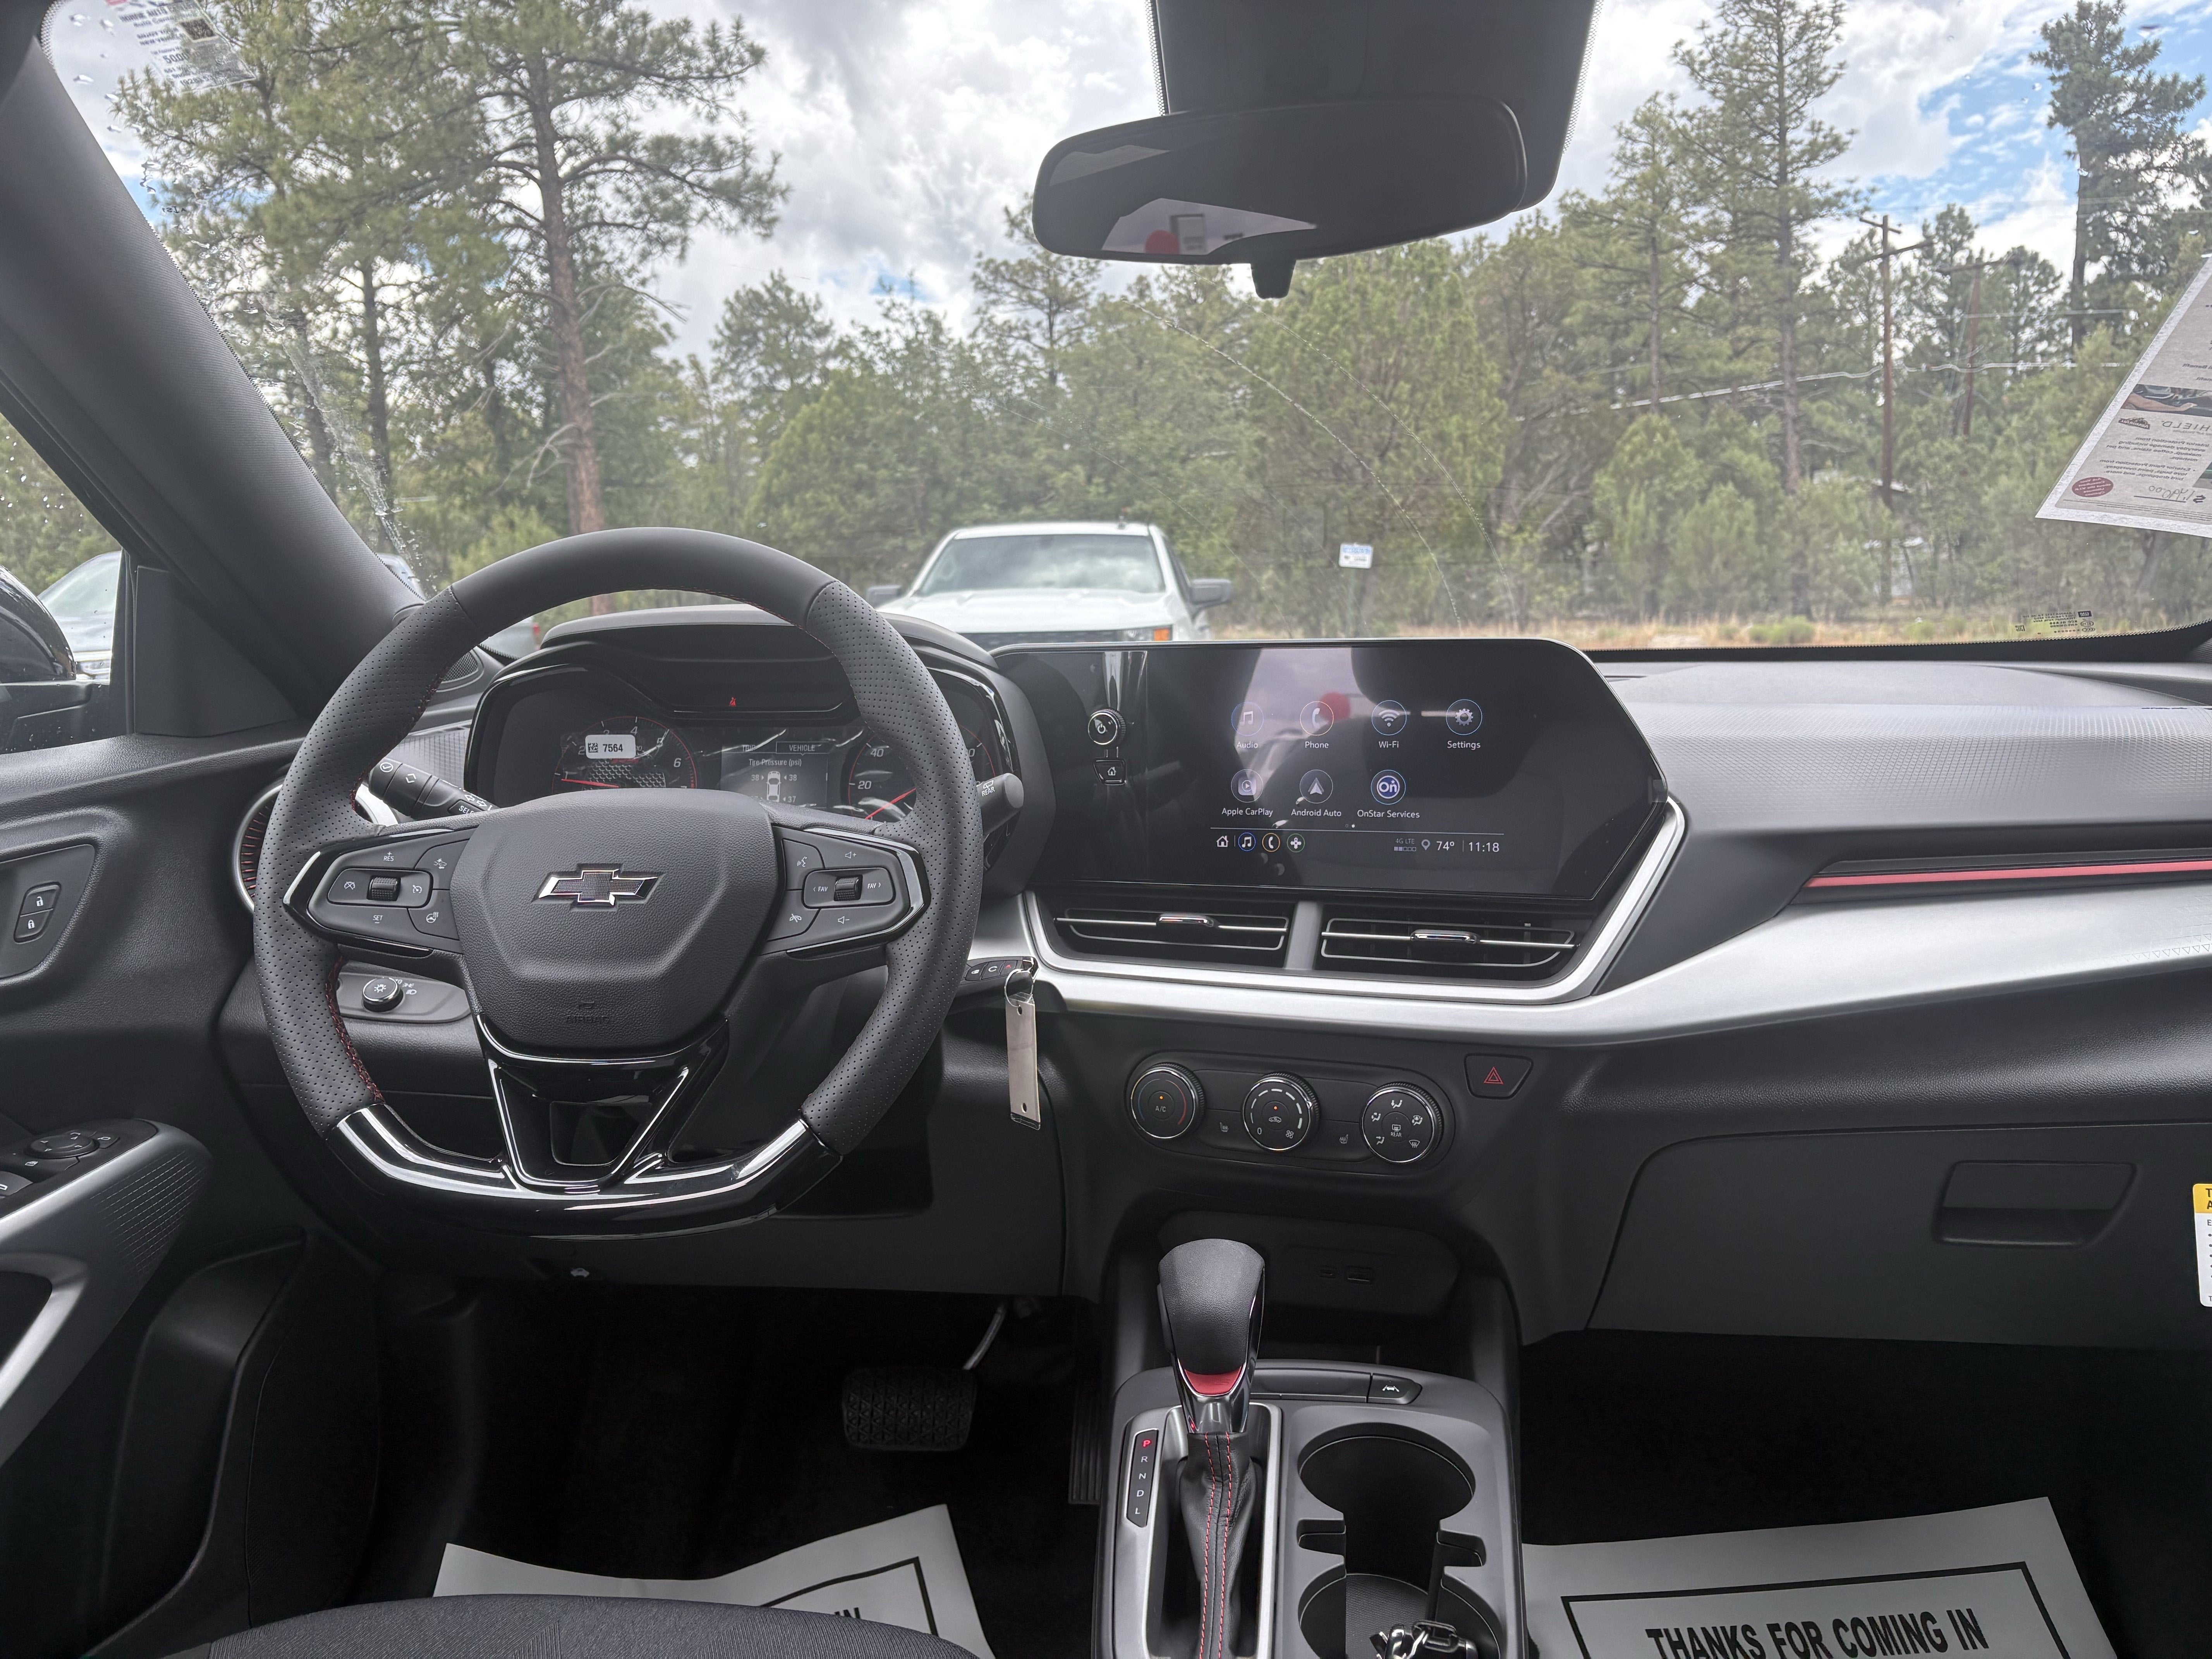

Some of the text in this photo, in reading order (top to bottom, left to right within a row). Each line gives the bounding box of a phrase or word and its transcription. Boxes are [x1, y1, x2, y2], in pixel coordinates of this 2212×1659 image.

[630, 726, 637, 735] 4
[603, 744, 623, 752] 7564
[1447, 741, 1481, 750] Settings
[578, 746, 585, 755] 2
[870, 749, 884, 757] 40
[673, 758, 681, 767] 6
[858, 781, 872, 790] 20
[981, 786, 995, 797] REAR
[1222, 808, 1273, 817] Apple CarPlay
[1291, 809, 1322, 817] Android
[1357, 809, 1384, 817] OnStar
[1468, 842, 1499, 852] 11:18
[1645, 1608, 1990, 1659] THANKS FOR COMING IN
